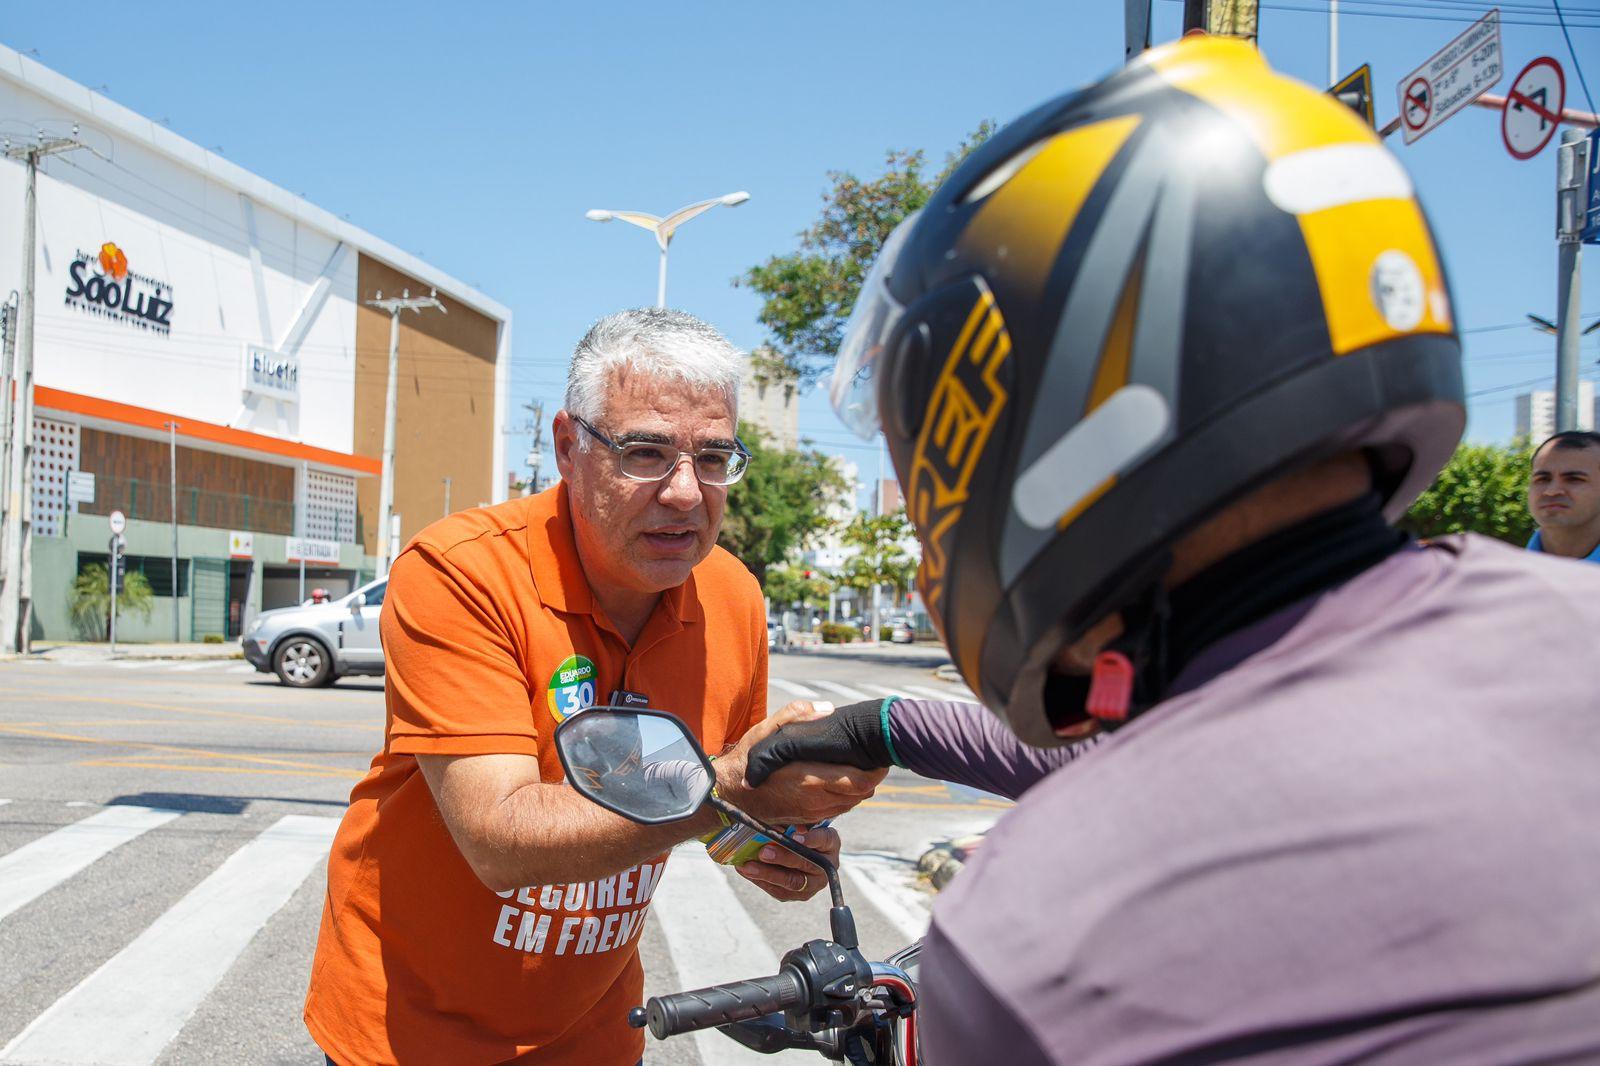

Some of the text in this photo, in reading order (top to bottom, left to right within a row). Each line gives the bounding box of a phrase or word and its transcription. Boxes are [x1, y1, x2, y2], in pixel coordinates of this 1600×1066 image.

[560, 666, 592, 681] EDUARDO
[562, 682, 594, 715] 30
[493, 904, 552, 954] EM
